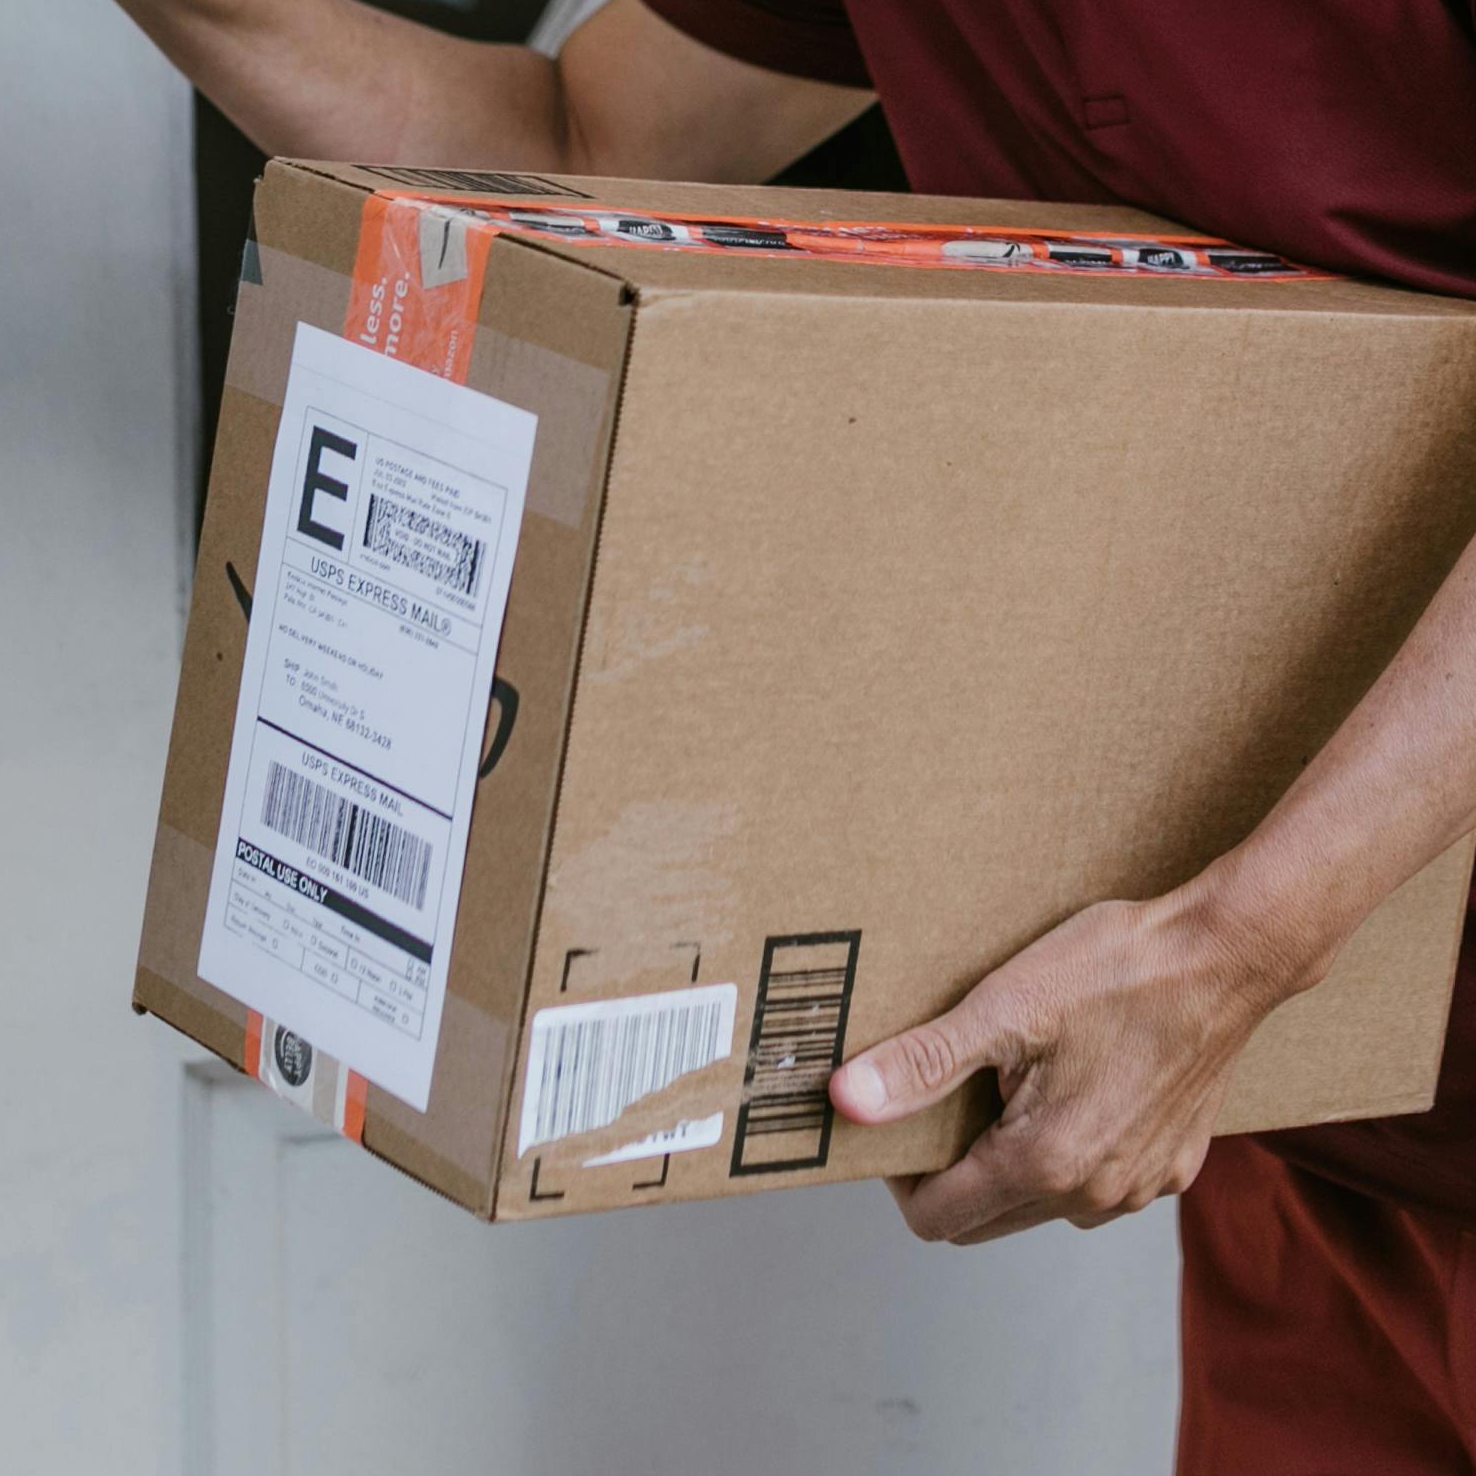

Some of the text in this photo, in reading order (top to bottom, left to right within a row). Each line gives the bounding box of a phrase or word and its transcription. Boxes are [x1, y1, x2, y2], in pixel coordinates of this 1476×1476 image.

[360, 276, 389, 346] less.
[443, 330, 458, 378] mazon
[297, 426, 357, 551] E
[310, 556, 345, 586] USPS
[347, 573, 408, 616] EXPRESS
[298, 694, 329, 721] Omaha,
[301, 751, 403, 817] USPS EXPRESS MAIL
[238, 842, 275, 876] POSTAL
[277, 864, 298, 888] USE
[299, 876, 327, 902] ONLY
